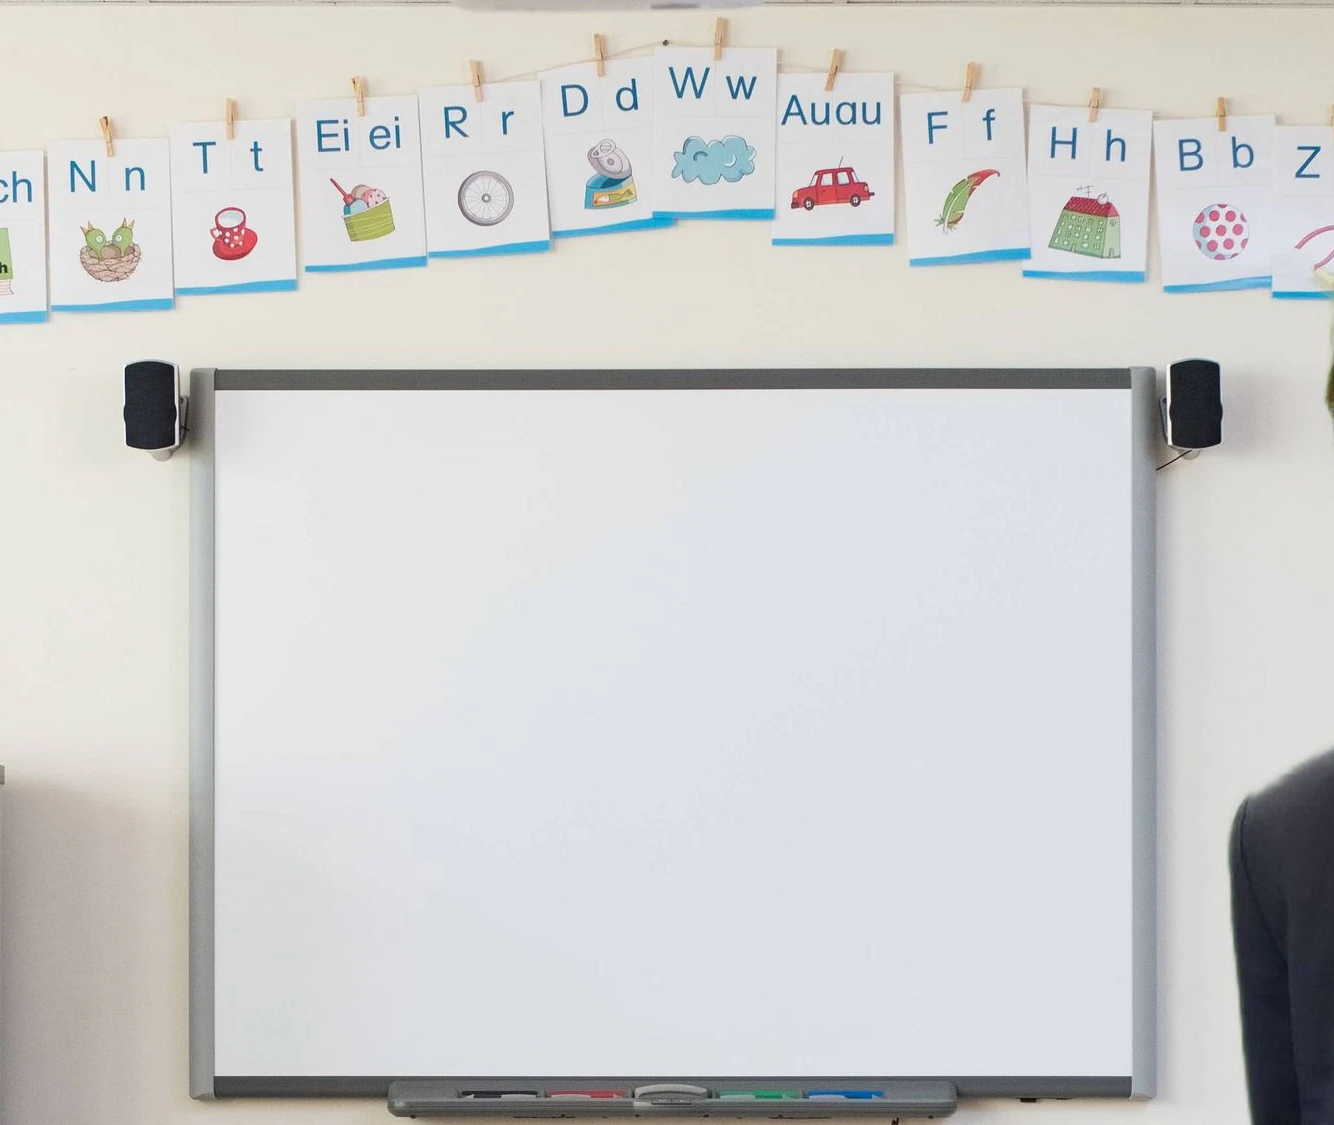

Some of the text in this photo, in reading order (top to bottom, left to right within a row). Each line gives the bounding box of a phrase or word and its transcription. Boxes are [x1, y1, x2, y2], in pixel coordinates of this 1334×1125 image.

[561, 78, 638, 117] D d
[669, 67, 757, 100] W w
[317, 116, 400, 152] Ei ei
[444, 106, 514, 138] R r
[927, 109, 995, 144] F f
[193, 142, 263, 174] T t
[1051, 127, 1126, 162] H h
[1179, 136, 1254, 171] B b
[70, 160, 145, 192] N n
[1295, 146, 1321, 178] Z
